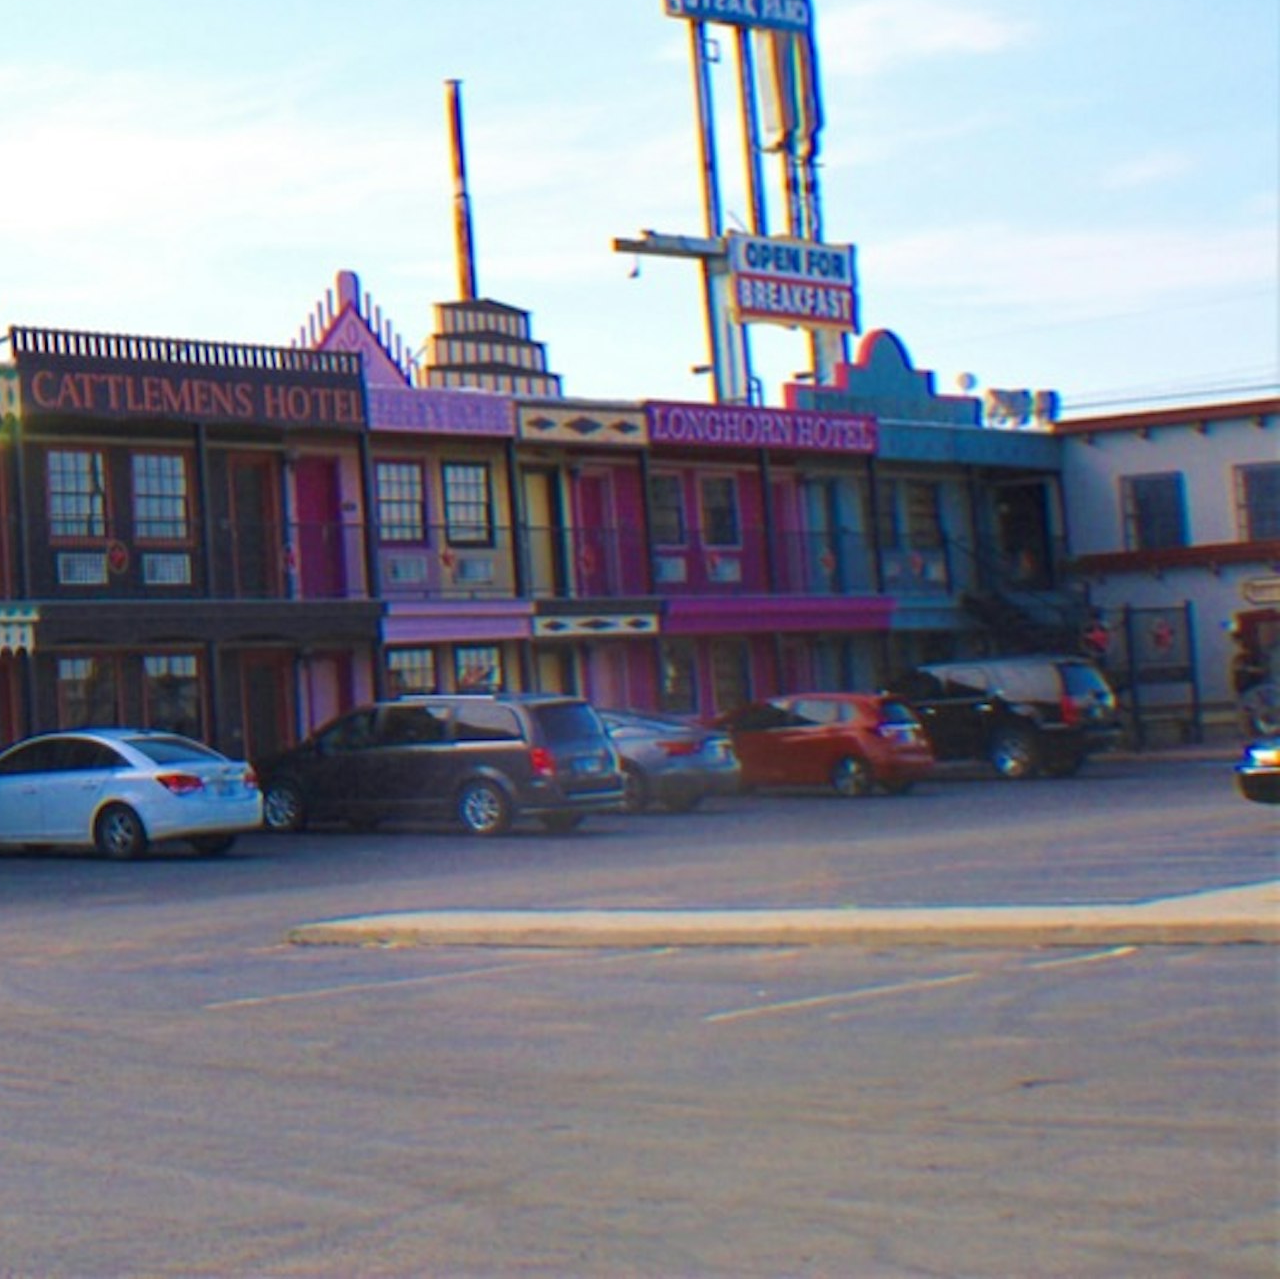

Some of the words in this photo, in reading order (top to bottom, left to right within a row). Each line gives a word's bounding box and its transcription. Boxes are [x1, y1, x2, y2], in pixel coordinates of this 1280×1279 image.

[745, 241, 802, 274] OPEN
[805, 247, 847, 281] FOR
[738, 278, 851, 321] BREAKFAST
[30, 370, 253, 417] CATTLEMENS
[263, 384, 362, 423] HOTEL
[651, 406, 791, 445] LONGHORN
[796, 415, 874, 451] HOTEL
